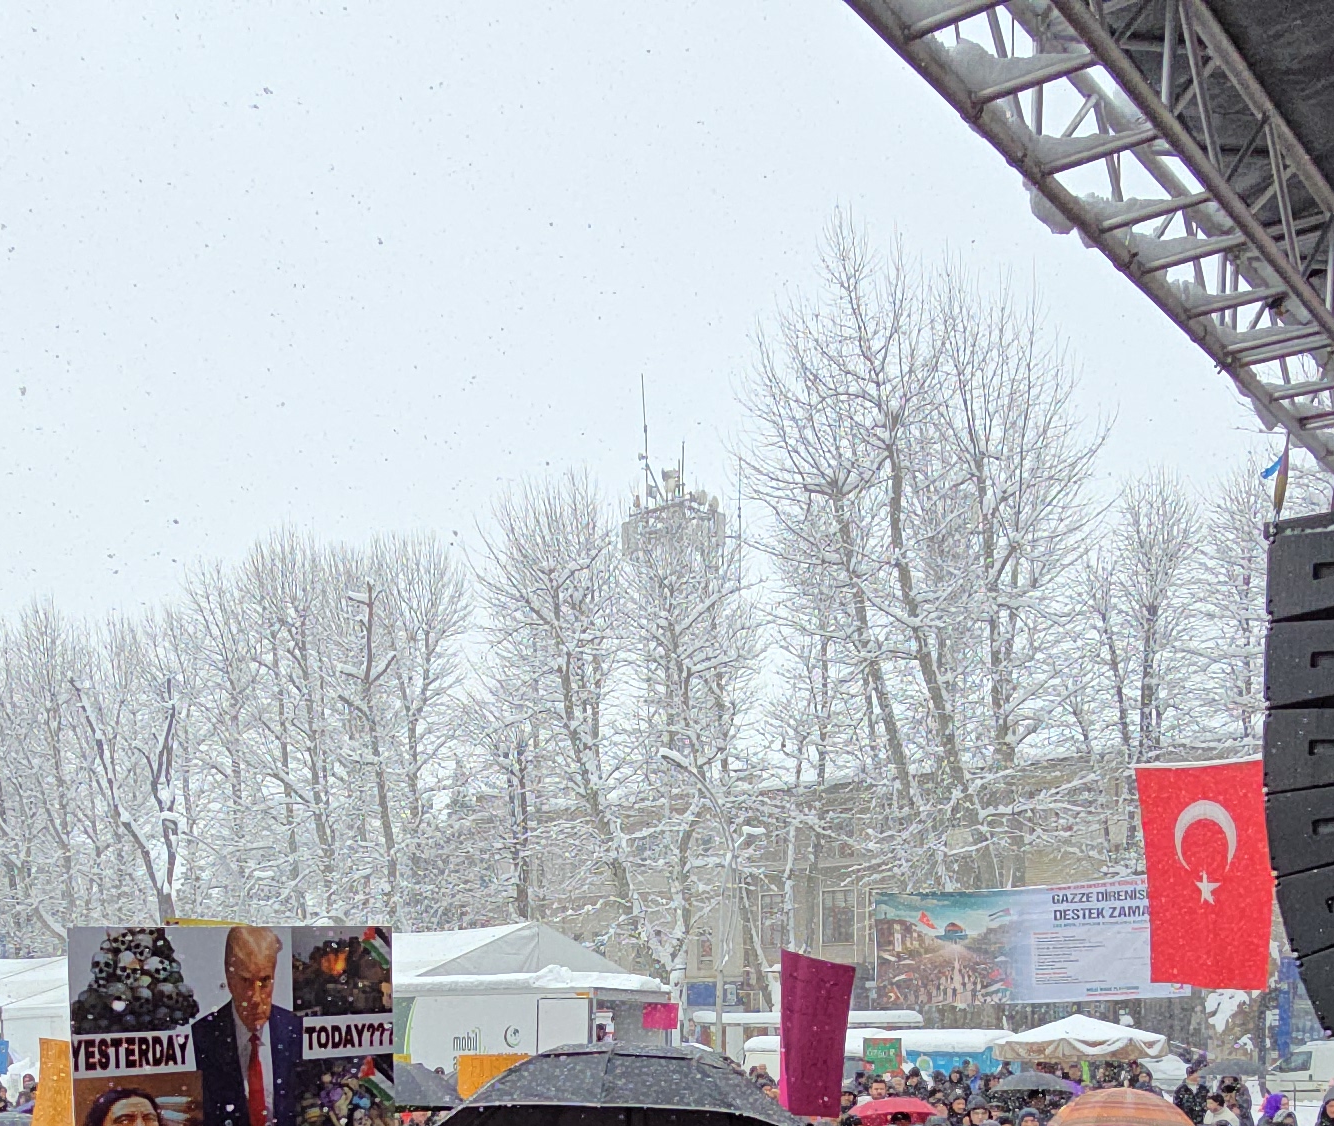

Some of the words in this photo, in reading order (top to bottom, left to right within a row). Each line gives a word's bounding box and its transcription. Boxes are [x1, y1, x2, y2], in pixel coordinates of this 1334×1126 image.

[1052, 892, 1094, 905] GAZZE
[1054, 906, 1105, 922] DESTEK
[1109, 905, 1150, 919] ZAMA
[453, 1031, 478, 1052] mobil
[73, 1034, 190, 1071] YESTERDAY
